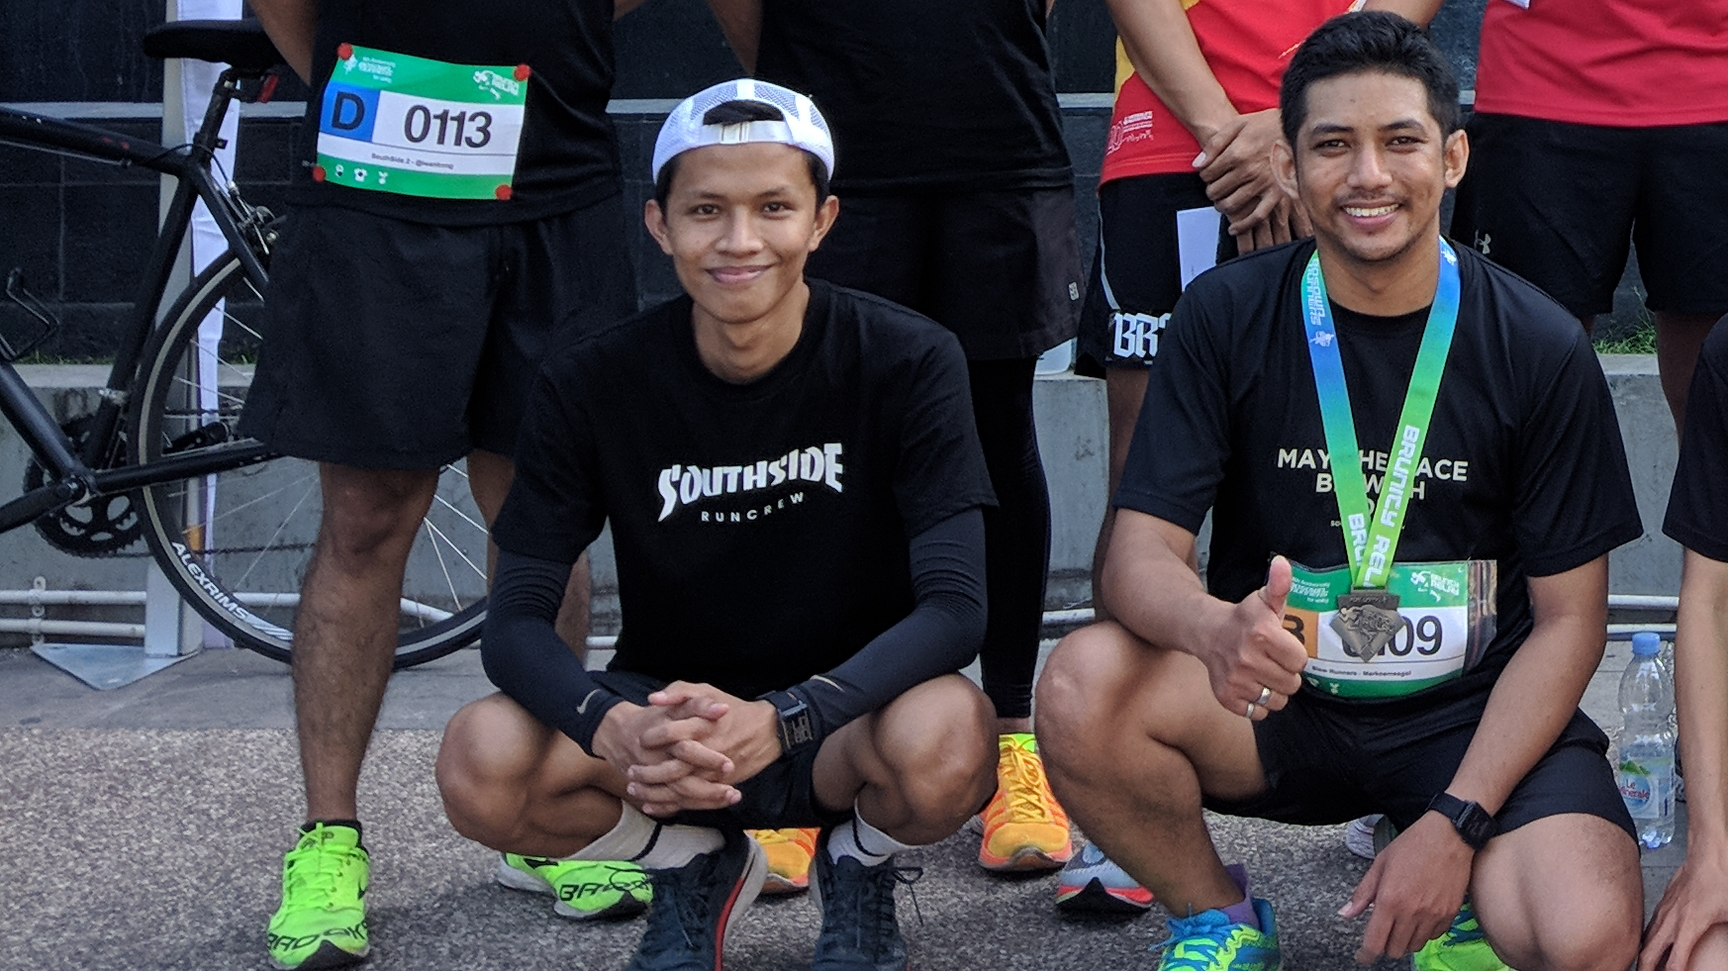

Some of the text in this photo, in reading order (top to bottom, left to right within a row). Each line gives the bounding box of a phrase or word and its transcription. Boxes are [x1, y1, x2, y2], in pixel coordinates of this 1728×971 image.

[330, 90, 494, 149] D 0113
[657, 442, 844, 523] SOUTHSIDE
[1276, 448, 1331, 470] MAY
[1414, 459, 1469, 482] ACE
[700, 491, 804, 523] RUNCREW
[171, 541, 250, 621] ALEXRIMS
